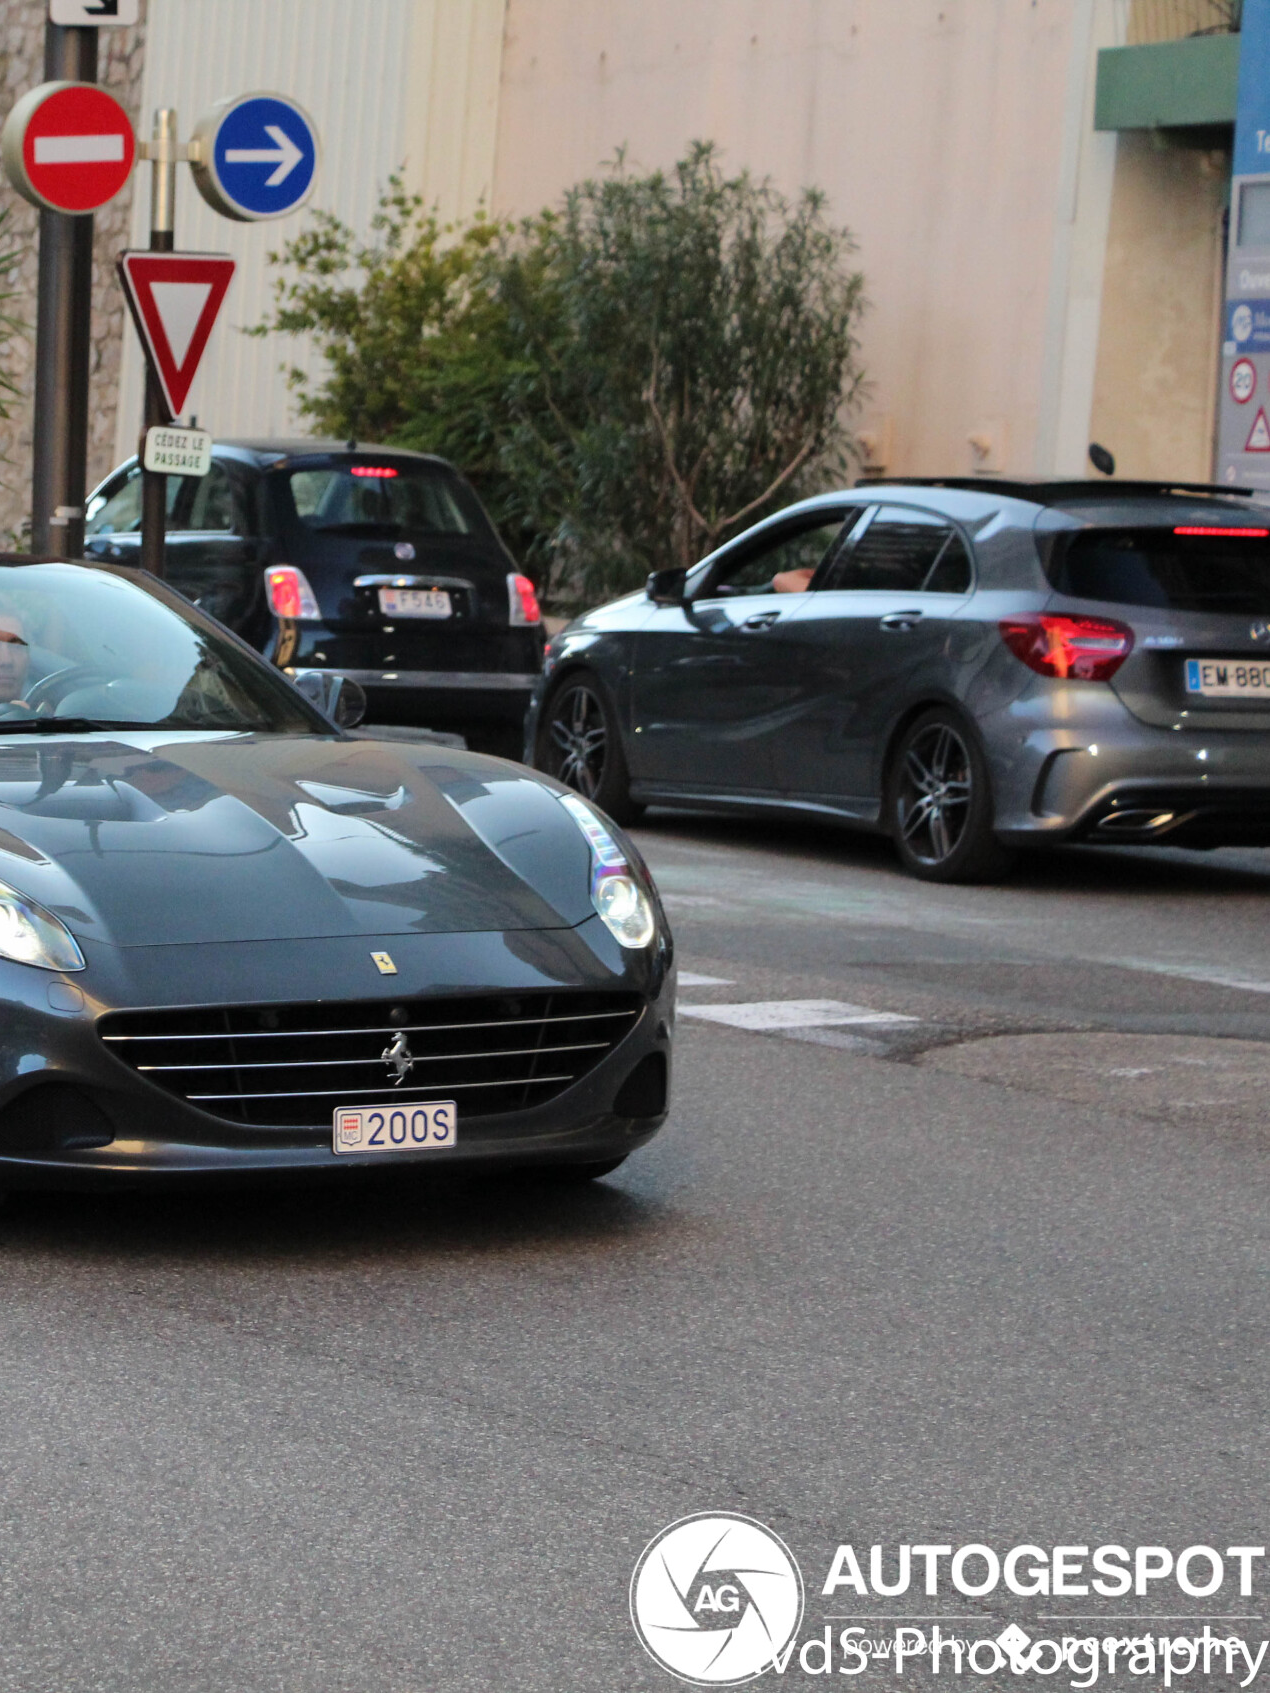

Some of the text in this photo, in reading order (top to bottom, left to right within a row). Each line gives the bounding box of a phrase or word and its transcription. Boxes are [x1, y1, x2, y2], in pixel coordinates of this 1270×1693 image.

[155, 433, 204, 450] CÉDEZ LE
[154, 452, 201, 468] PASSAGE
[368, 1109, 449, 1145] 200S
[343, 1130, 358, 1141] MC
